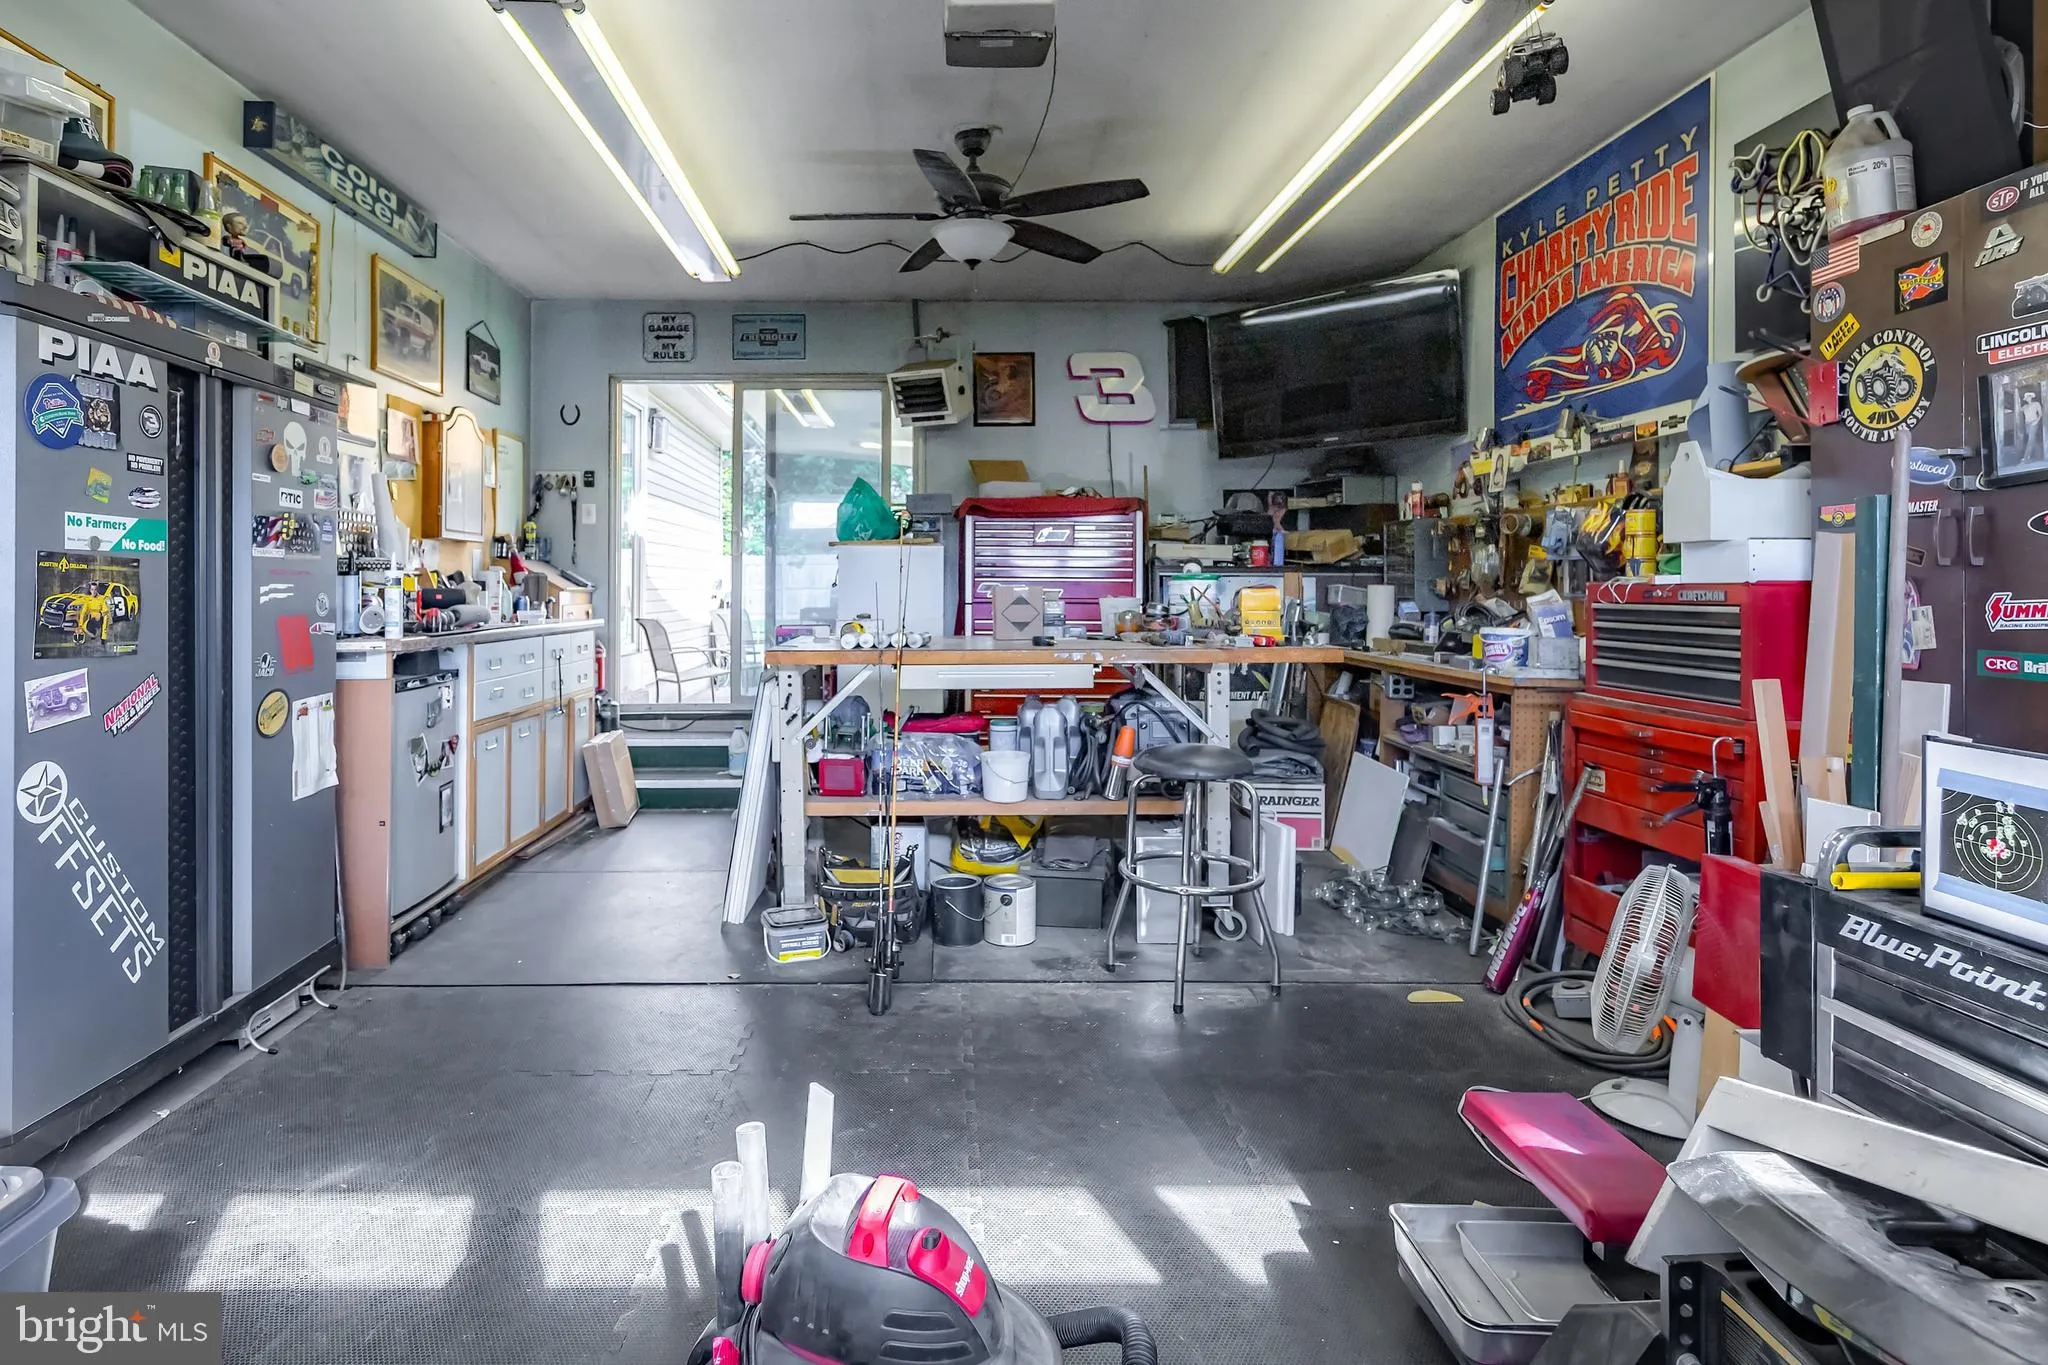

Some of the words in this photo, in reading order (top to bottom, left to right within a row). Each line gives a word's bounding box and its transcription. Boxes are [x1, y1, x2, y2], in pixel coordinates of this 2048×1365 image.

[320, 143, 398, 210] Cold
[2020, 179, 2028, 190] IF
[330, 168, 405, 230] Beer
[1502, 205, 1566, 258] KYLE
[1586, 126, 1698, 210] PETTY
[1991, 190, 2015, 208] STP
[2029, 185, 2045, 198] ALL
[1501, 200, 1614, 329] CHARITY
[1614, 151, 1699, 247] RIDE
[183, 252, 261, 309] PIAA
[1501, 269, 1574, 369] ACROSS
[1577, 243, 1697, 299] AMERICA
[1831, 320, 1849, 341] Auto
[39, 324, 158, 391] PIAA
[653, 351, 685, 359] RULES
[1840, 342, 1871, 384] OUTA
[1872, 329, 1936, 371] CONTROL
[1067, 352, 1156, 425] 3
[1840, 408, 1879, 442] SOUTH
[1867, 410, 1900, 424] 4WD
[1909, 460, 1949, 475] stwood
[281, 492, 302, 504] RTIC
[67, 515, 83, 527] No
[86, 517, 127, 530] Farmers
[121, 538, 136, 550] No
[138, 539, 165, 551] Food!
[1985, 659, 2018, 671] CRC
[104, 674, 158, 731] NATIONAL
[1249, 796, 1320, 807] RAINGER
[68, 797, 165, 951] CUSTOM
